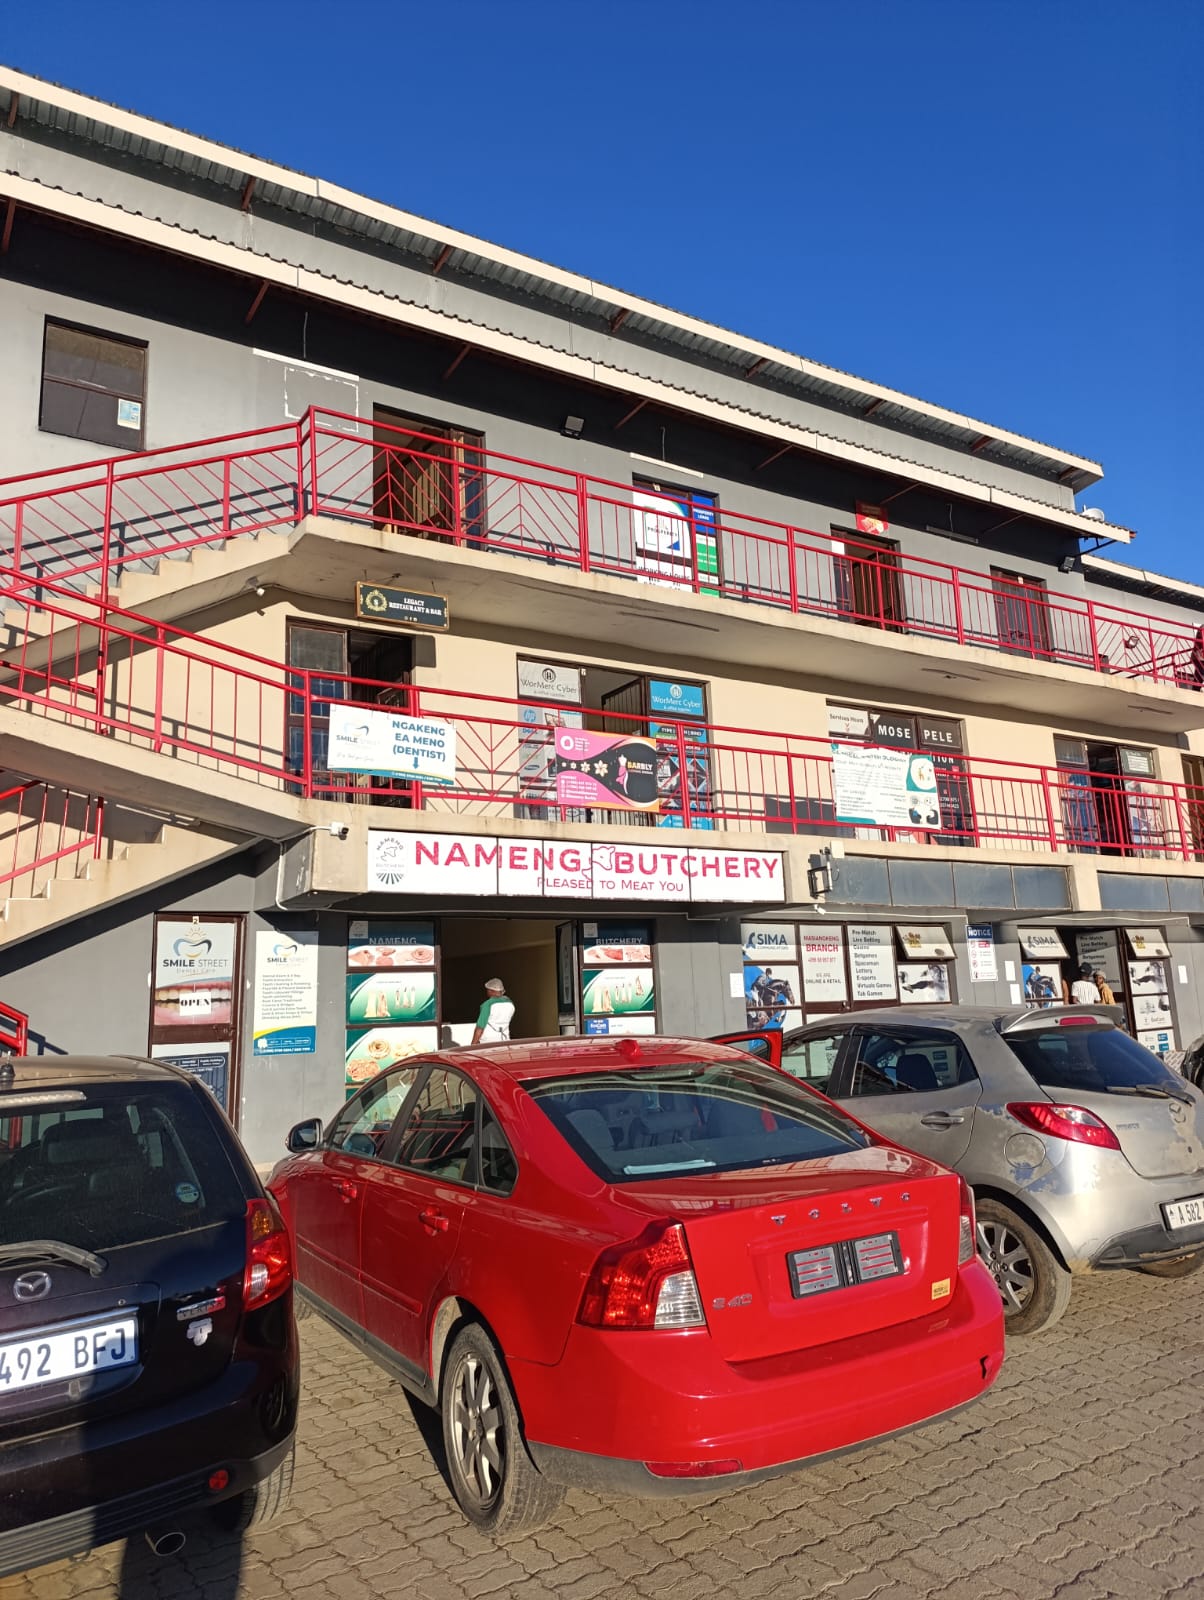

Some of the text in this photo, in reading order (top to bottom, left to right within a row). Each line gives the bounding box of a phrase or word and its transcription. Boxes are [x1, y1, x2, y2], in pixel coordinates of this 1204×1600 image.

[403, 597, 425, 607] LEGACY
[388, 601, 425, 613] RESTAURANT
[430, 608, 442, 616] BAR
[556, 684, 577, 694] Cyber
[683, 699, 701, 708] Cyber
[392, 720, 445, 736] NGAKENG
[335, 735, 358, 743] SMILE
[878, 725, 953, 743] MOSE PELE
[395, 733, 445, 748] EA MENO
[393, 744, 446, 762] (DENTIST)
[415, 840, 778, 879] NAMENG BUTCHERY
[537, 877, 683, 892] PLEASED TO MEAT YOU
[369, 937, 416, 945] NAMENG
[596, 937, 642, 945] BUTCHERY
[757, 933, 788, 945] SIMA
[1032, 936, 1056, 945] SIMA
[806, 943, 839, 952] BRANCH
[163, 959, 228, 967] SMILE STREET
[180, 999, 210, 1007] OPEN
[1185, 1202, 1202, 1222] 582
[0, 1328, 126, 1384] 492 BFJ
